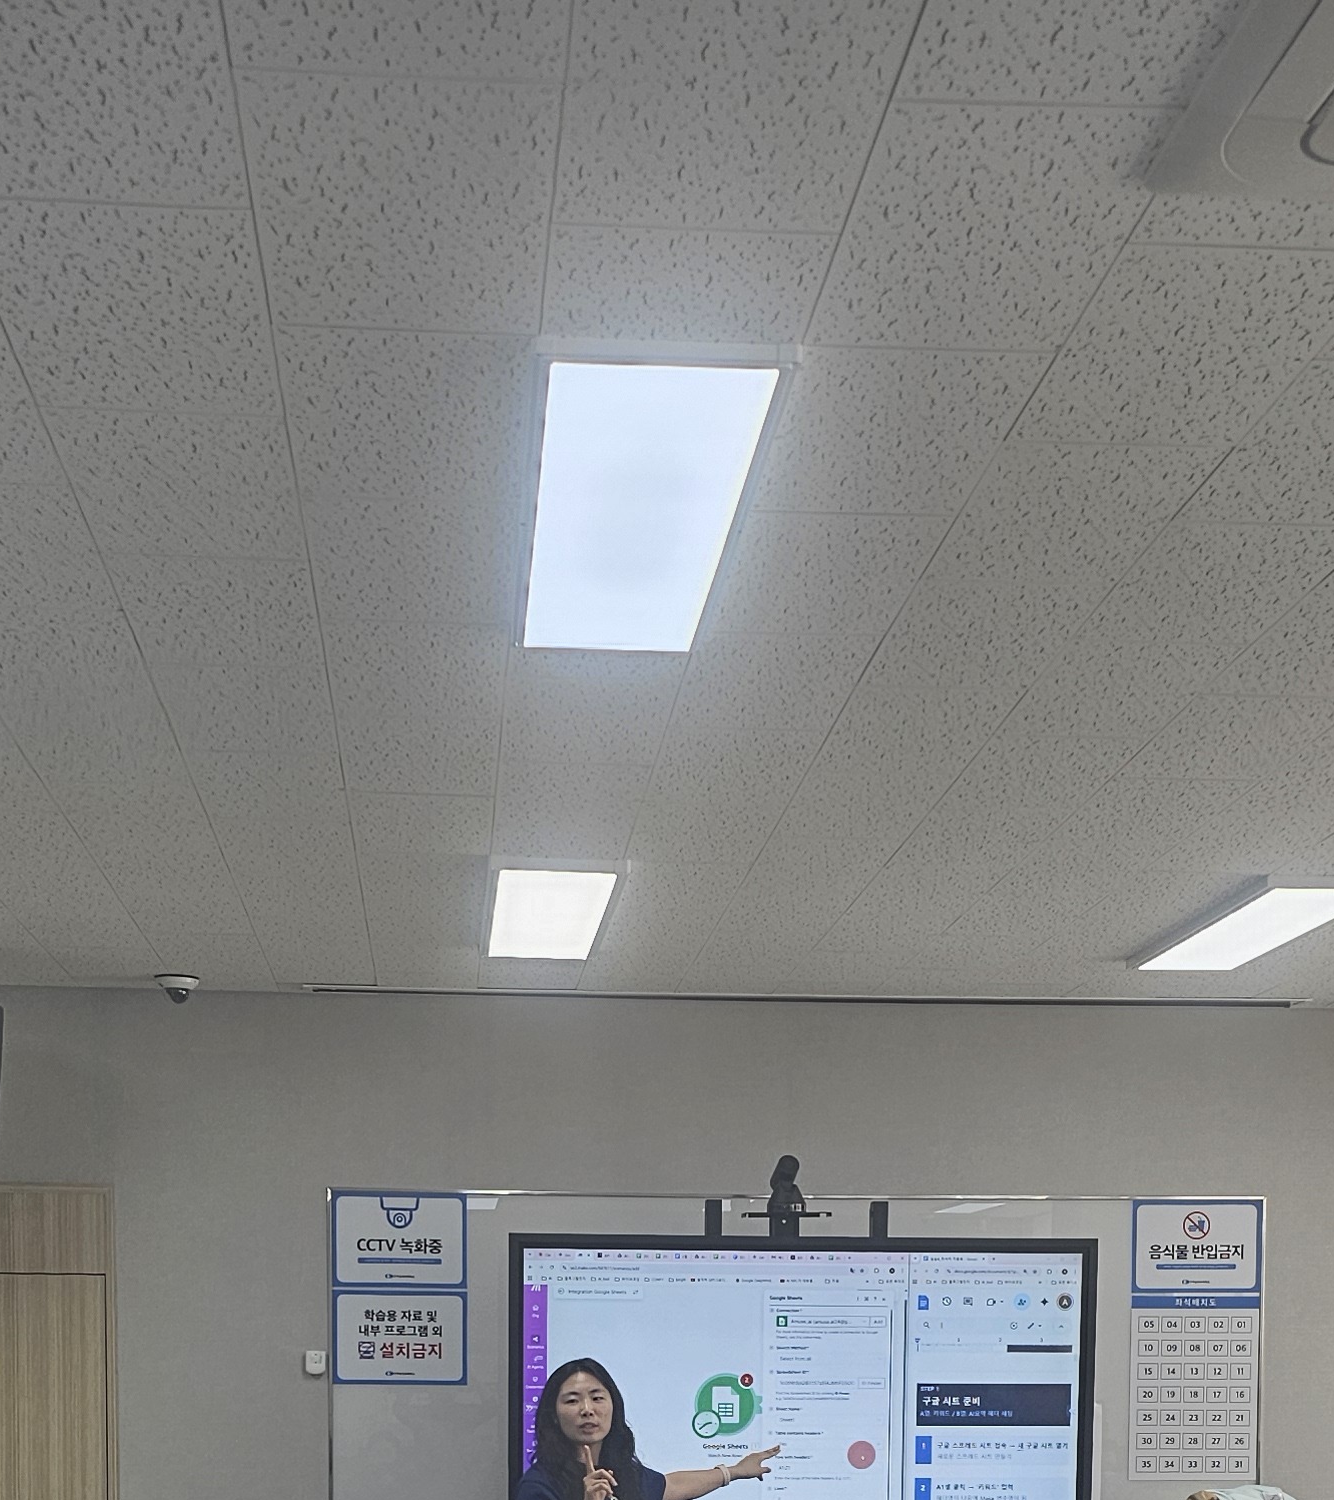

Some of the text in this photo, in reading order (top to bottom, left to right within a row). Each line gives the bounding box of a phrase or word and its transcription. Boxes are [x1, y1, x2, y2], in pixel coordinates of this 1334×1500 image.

[357, 1238, 443, 1254] CCTV 녹화중
[1149, 1244, 1244, 1260] 음식물 반입금지
[364, 1310, 437, 1322] 학습용 자료 및
[1144, 1320, 1154, 1328] 05
[359, 1325, 443, 1337] 내부 프로그램 외
[380, 1342, 442, 1359] 설치금지
[1167, 1344, 1177, 1352] 09
[1190, 1344, 1200, 1352] 08
[1236, 1344, 1246, 1352] 06
[922, 1396, 981, 1407] 구글 시트 준비
[703, 1443, 725, 1451] Google
